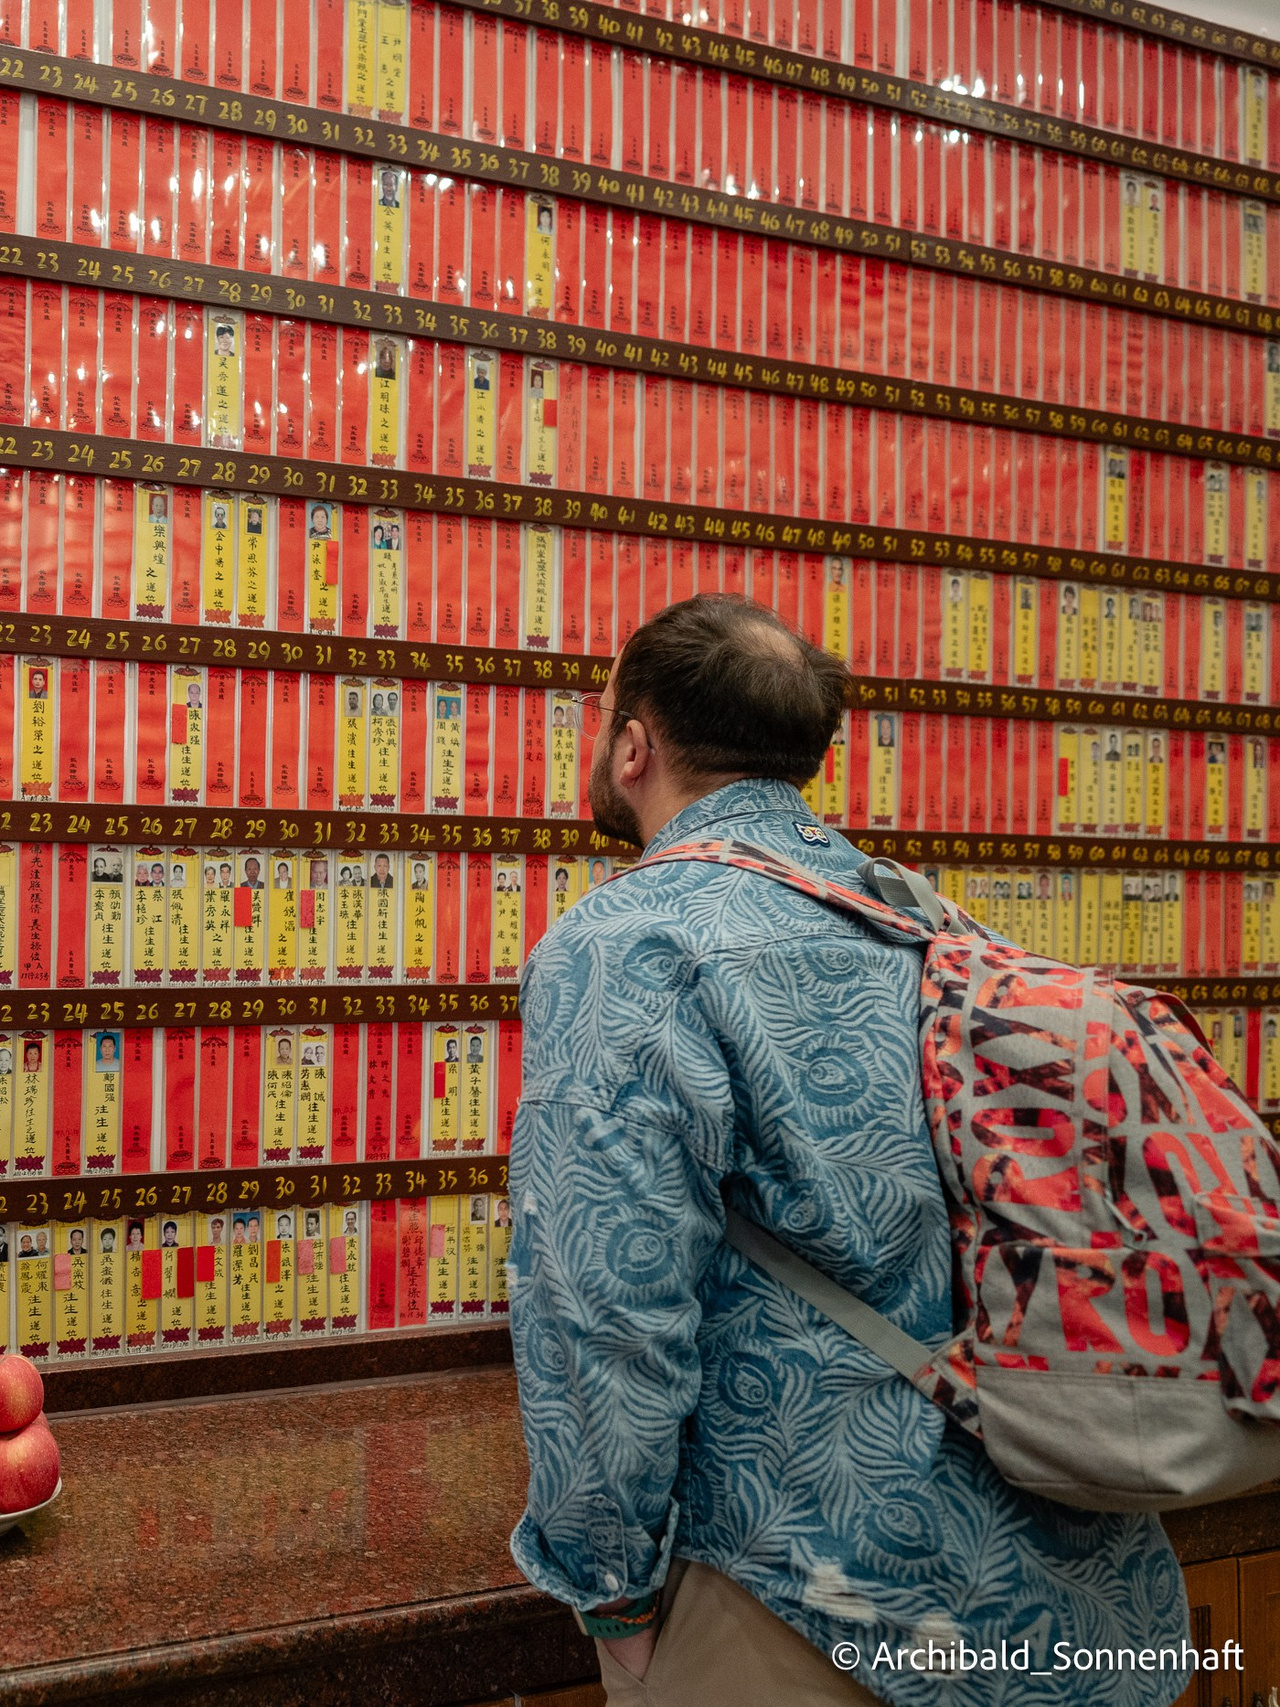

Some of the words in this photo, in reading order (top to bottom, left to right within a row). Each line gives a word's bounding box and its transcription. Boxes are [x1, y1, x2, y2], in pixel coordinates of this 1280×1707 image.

[1113, 282, 1127, 297] 61
[1133, 286, 1148, 303] 62
[211, 460, 237, 483] 28
[246, 464, 271, 485] 29
[284, 466, 304, 487] 30
[315, 644, 332, 665] 31
[347, 647, 367, 668] 32
[860, 684, 876, 701] 50
[884, 686, 899, 702] 51
[909, 687, 926, 705] 52
[28, 812, 53, 833] 23
[66, 814, 91, 834] 24
[208, 1000, 232, 1020] 28
[242, 998, 264, 1018] 29
[277, 997, 296, 1015] 30
[275, 1176, 295, 1200] 30
[310, 1174, 327, 1198] 31
[342, 1174, 361, 1195] 32
